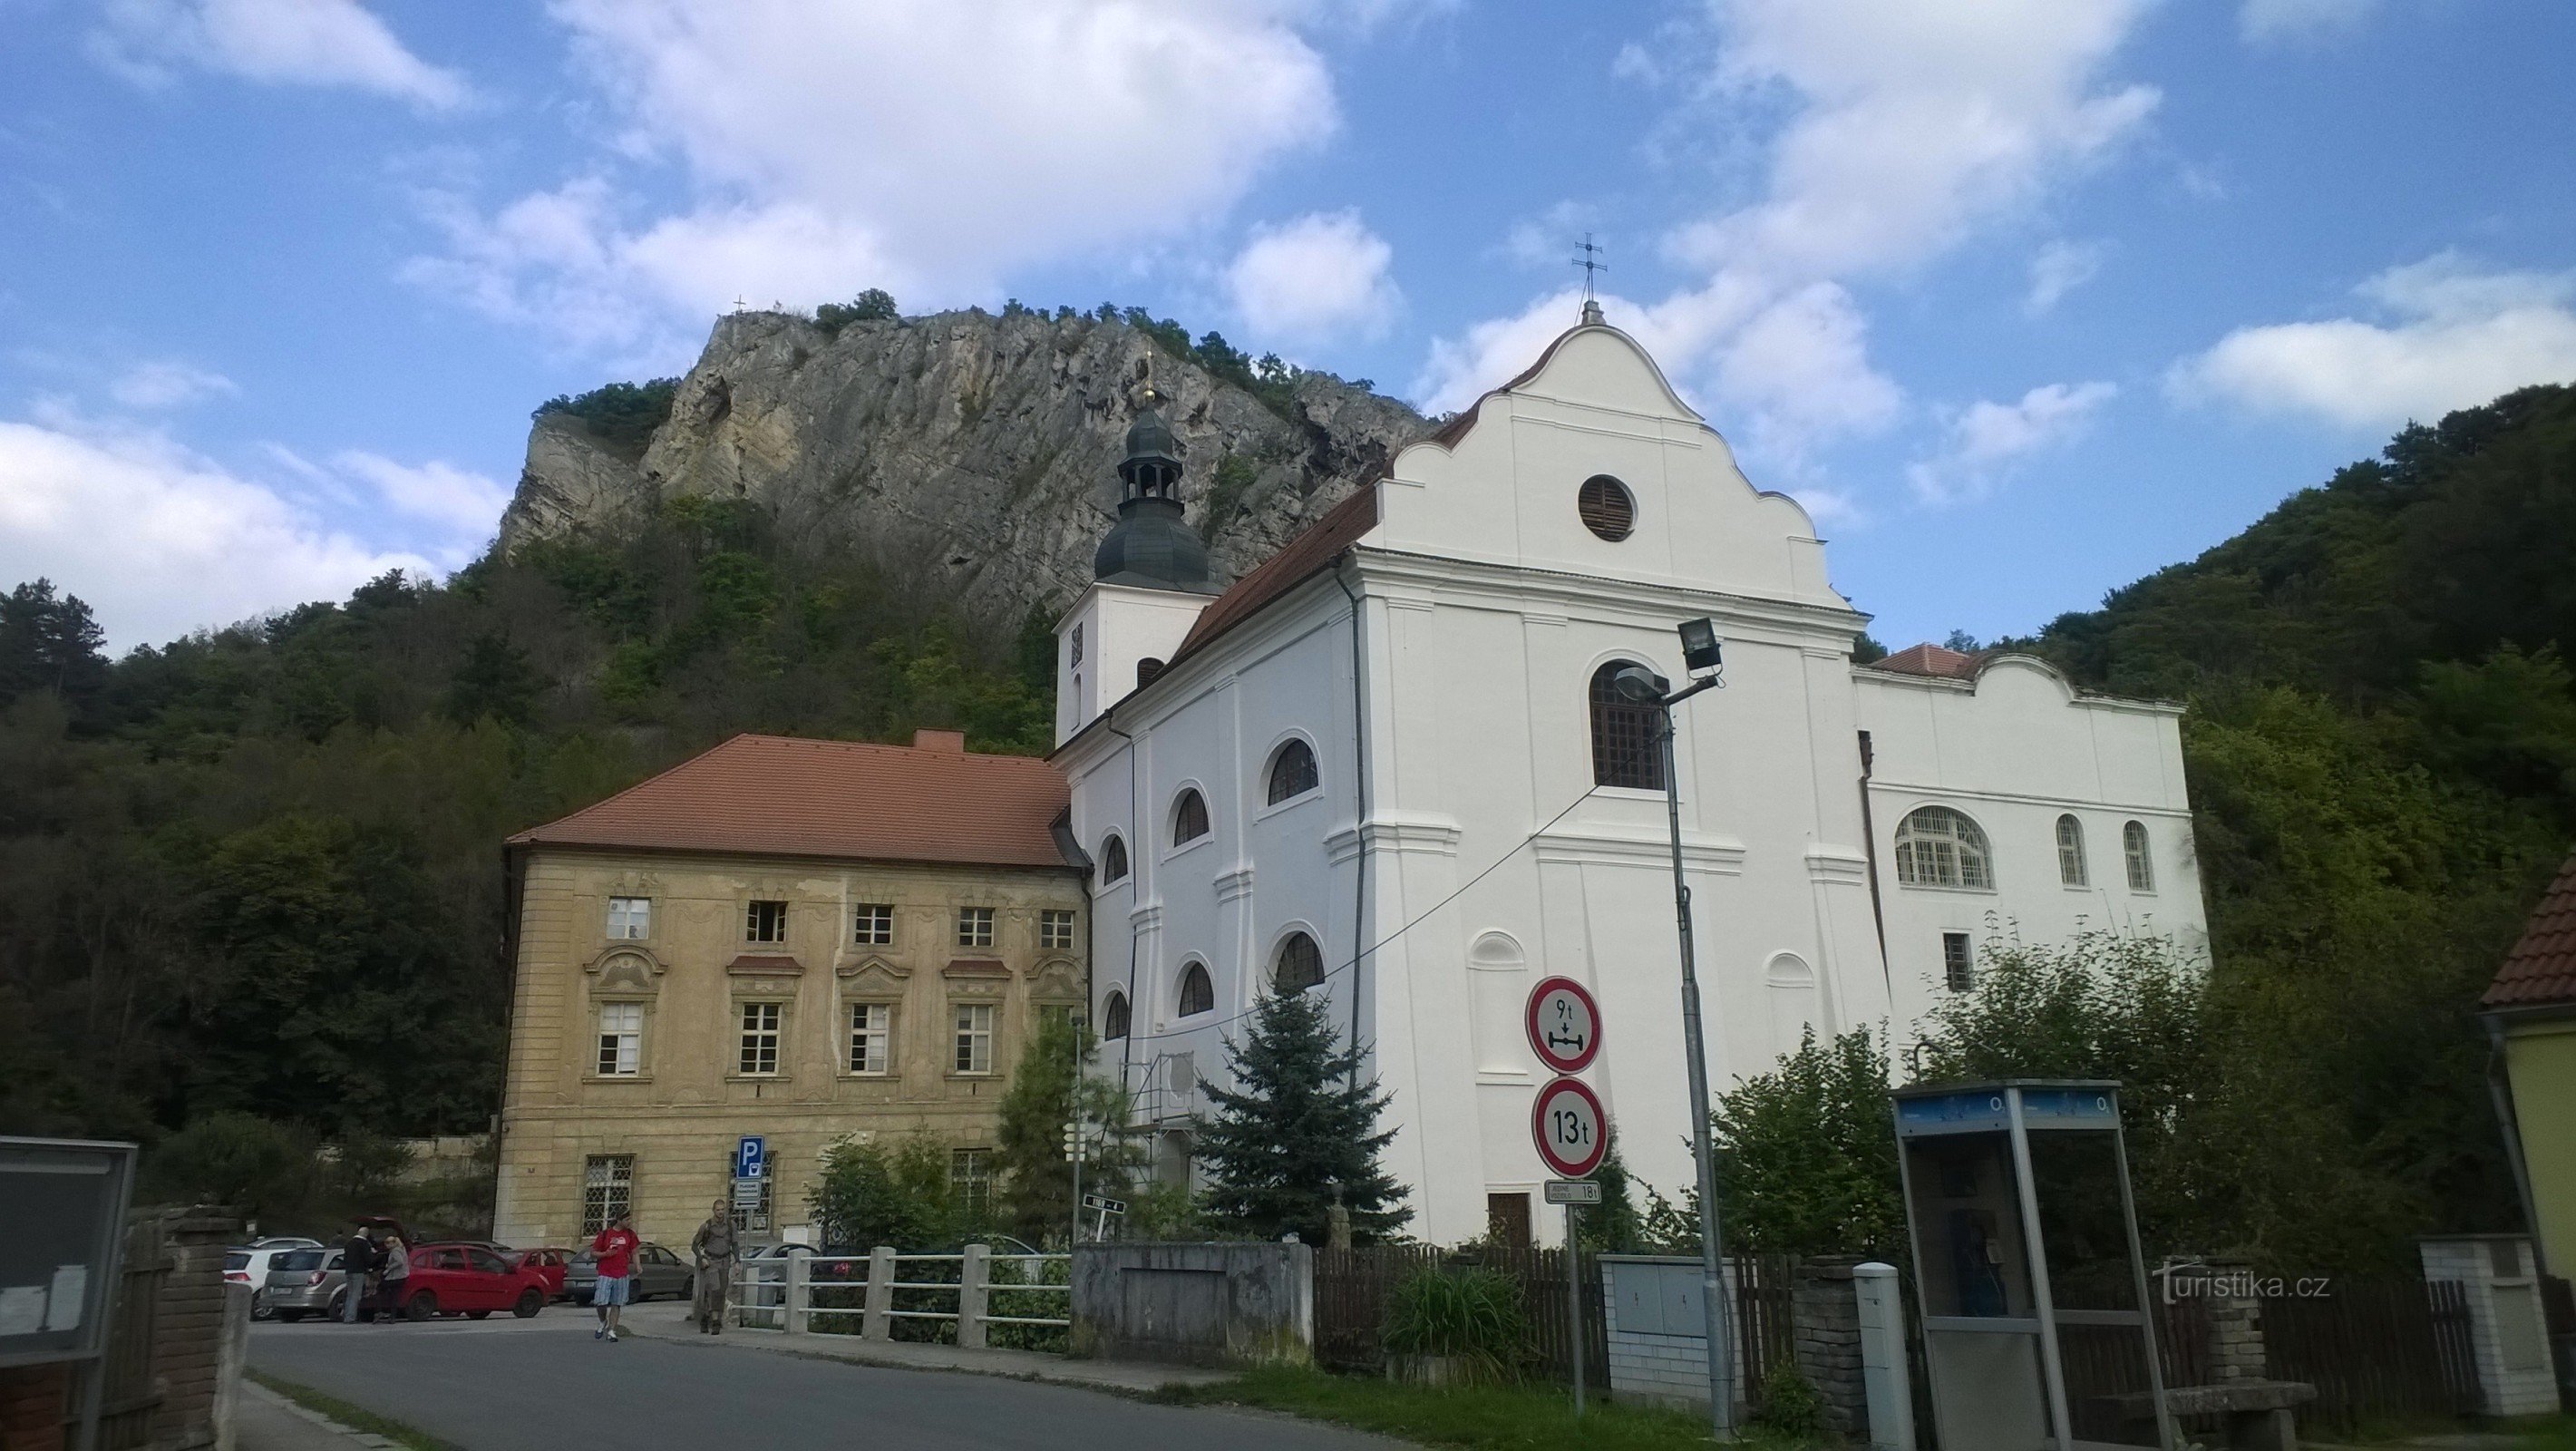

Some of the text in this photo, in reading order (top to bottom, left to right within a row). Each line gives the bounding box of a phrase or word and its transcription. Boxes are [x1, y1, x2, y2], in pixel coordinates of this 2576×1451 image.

[1556, 999, 1572, 1020] 9t
[1553, 1110, 1589, 1144] 13t
[743, 1142, 758, 1165] P
[1583, 1185, 1598, 1198] 18t
